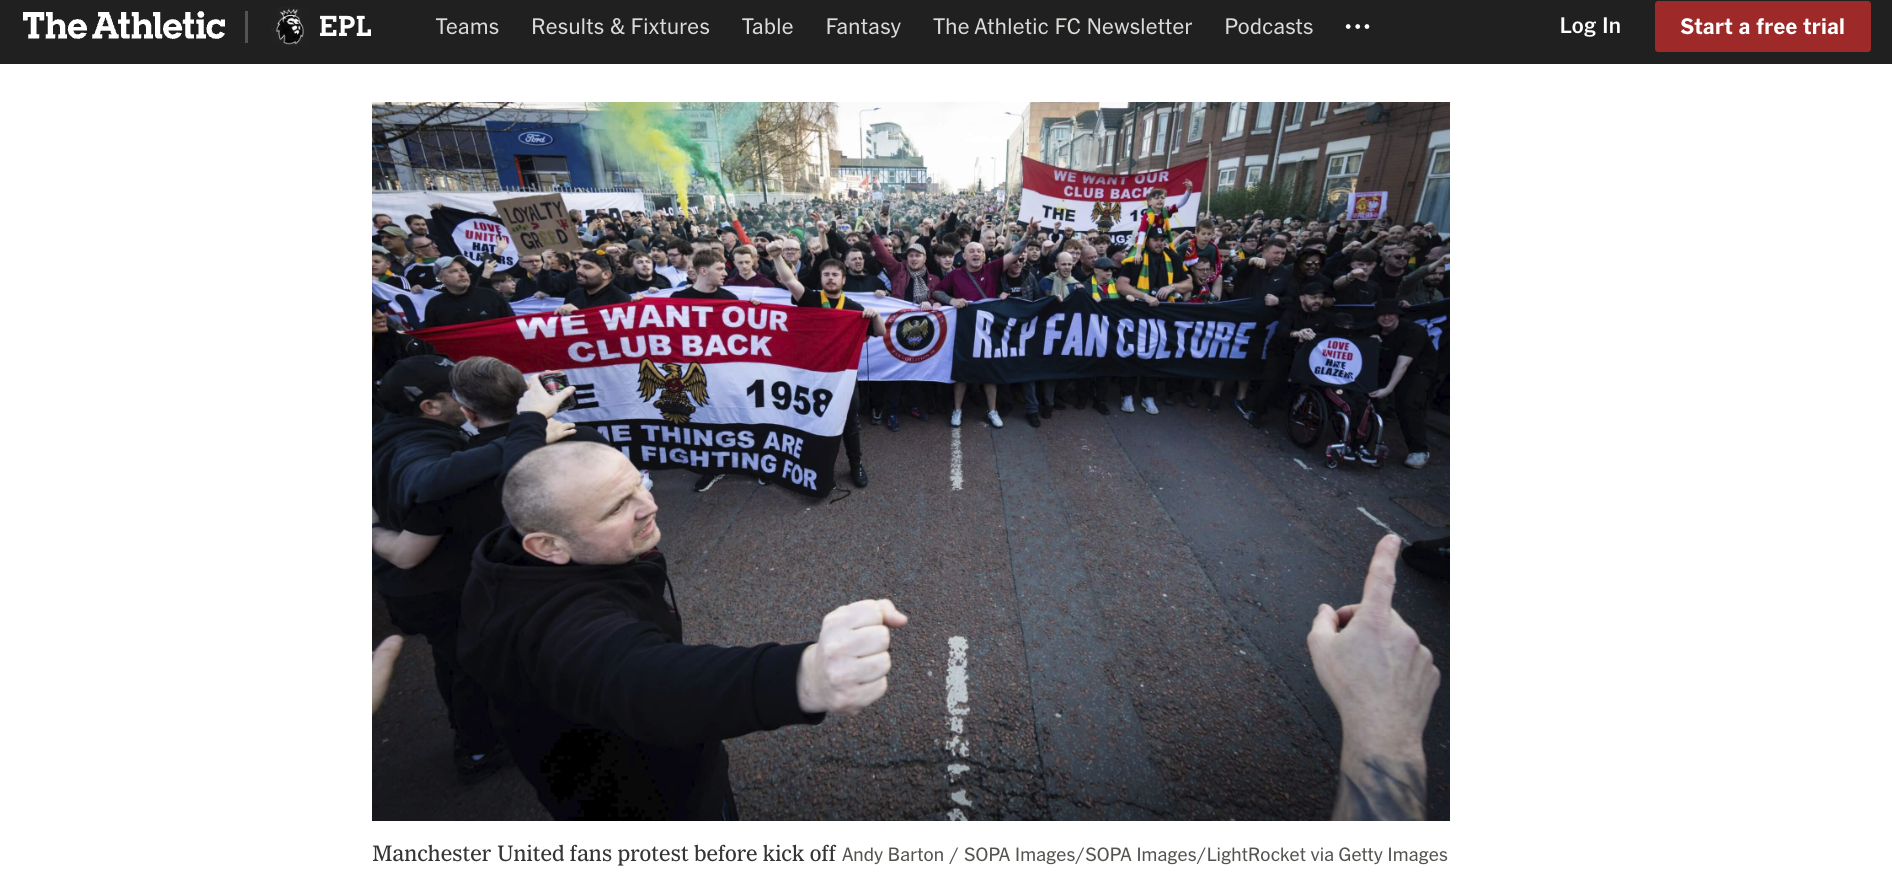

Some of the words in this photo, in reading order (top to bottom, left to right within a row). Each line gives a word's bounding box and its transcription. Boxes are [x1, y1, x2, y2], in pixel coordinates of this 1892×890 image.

[525, 133, 546, 143] Ford
[1054, 169, 1076, 182] WE
[1082, 173, 1129, 185] WANT
[1134, 170, 1170, 184] OUR
[1063, 185, 1105, 199] CLUB
[1110, 186, 1154, 200] BACK
[503, 201, 563, 224] LOYALTY
[1042, 205, 1076, 222] THE
[473, 221, 501, 232] LOVE
[465, 230, 510, 244] UNITD
[472, 242, 496, 253] HAT
[515, 314, 589, 340] WE
[598, 305, 713, 331] WANT
[721, 305, 789, 332] OUR
[1043, 312, 1110, 357] FAN
[1115, 317, 1257, 360] CULTURE
[567, 334, 672, 363] CLUB
[681, 334, 773, 357] BACK
[1327, 340, 1350, 351] LOVE
[1322, 349, 1354, 361] UNITED
[746, 378, 834, 418] 1958
[640, 424, 755, 449] THINGS
[763, 430, 804, 460] ARE
[641, 445, 777, 473] FIGHTING
[782, 458, 818, 491] FOR
